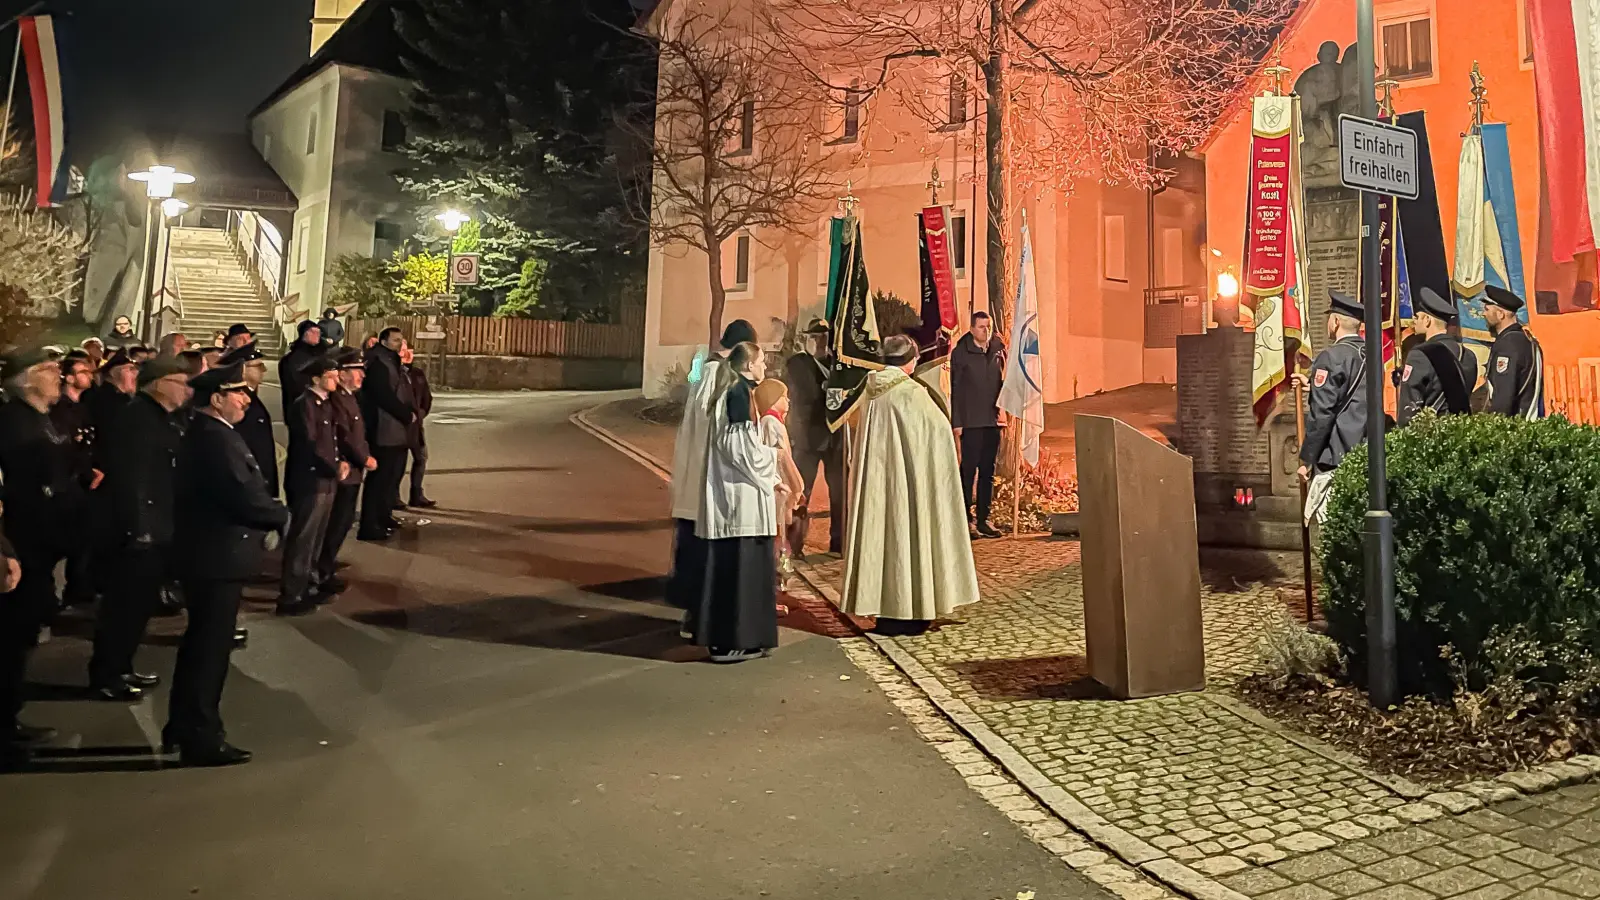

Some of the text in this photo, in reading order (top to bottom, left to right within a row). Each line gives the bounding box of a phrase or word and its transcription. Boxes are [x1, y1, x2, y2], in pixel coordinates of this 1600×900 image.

[1354, 131, 1404, 159] Einfahrt
[1349, 155, 1410, 185] freihalten
[1261, 190, 1280, 200] Kastl
[1262, 210, 1274, 218] 100
[460, 262, 470, 271] 30
